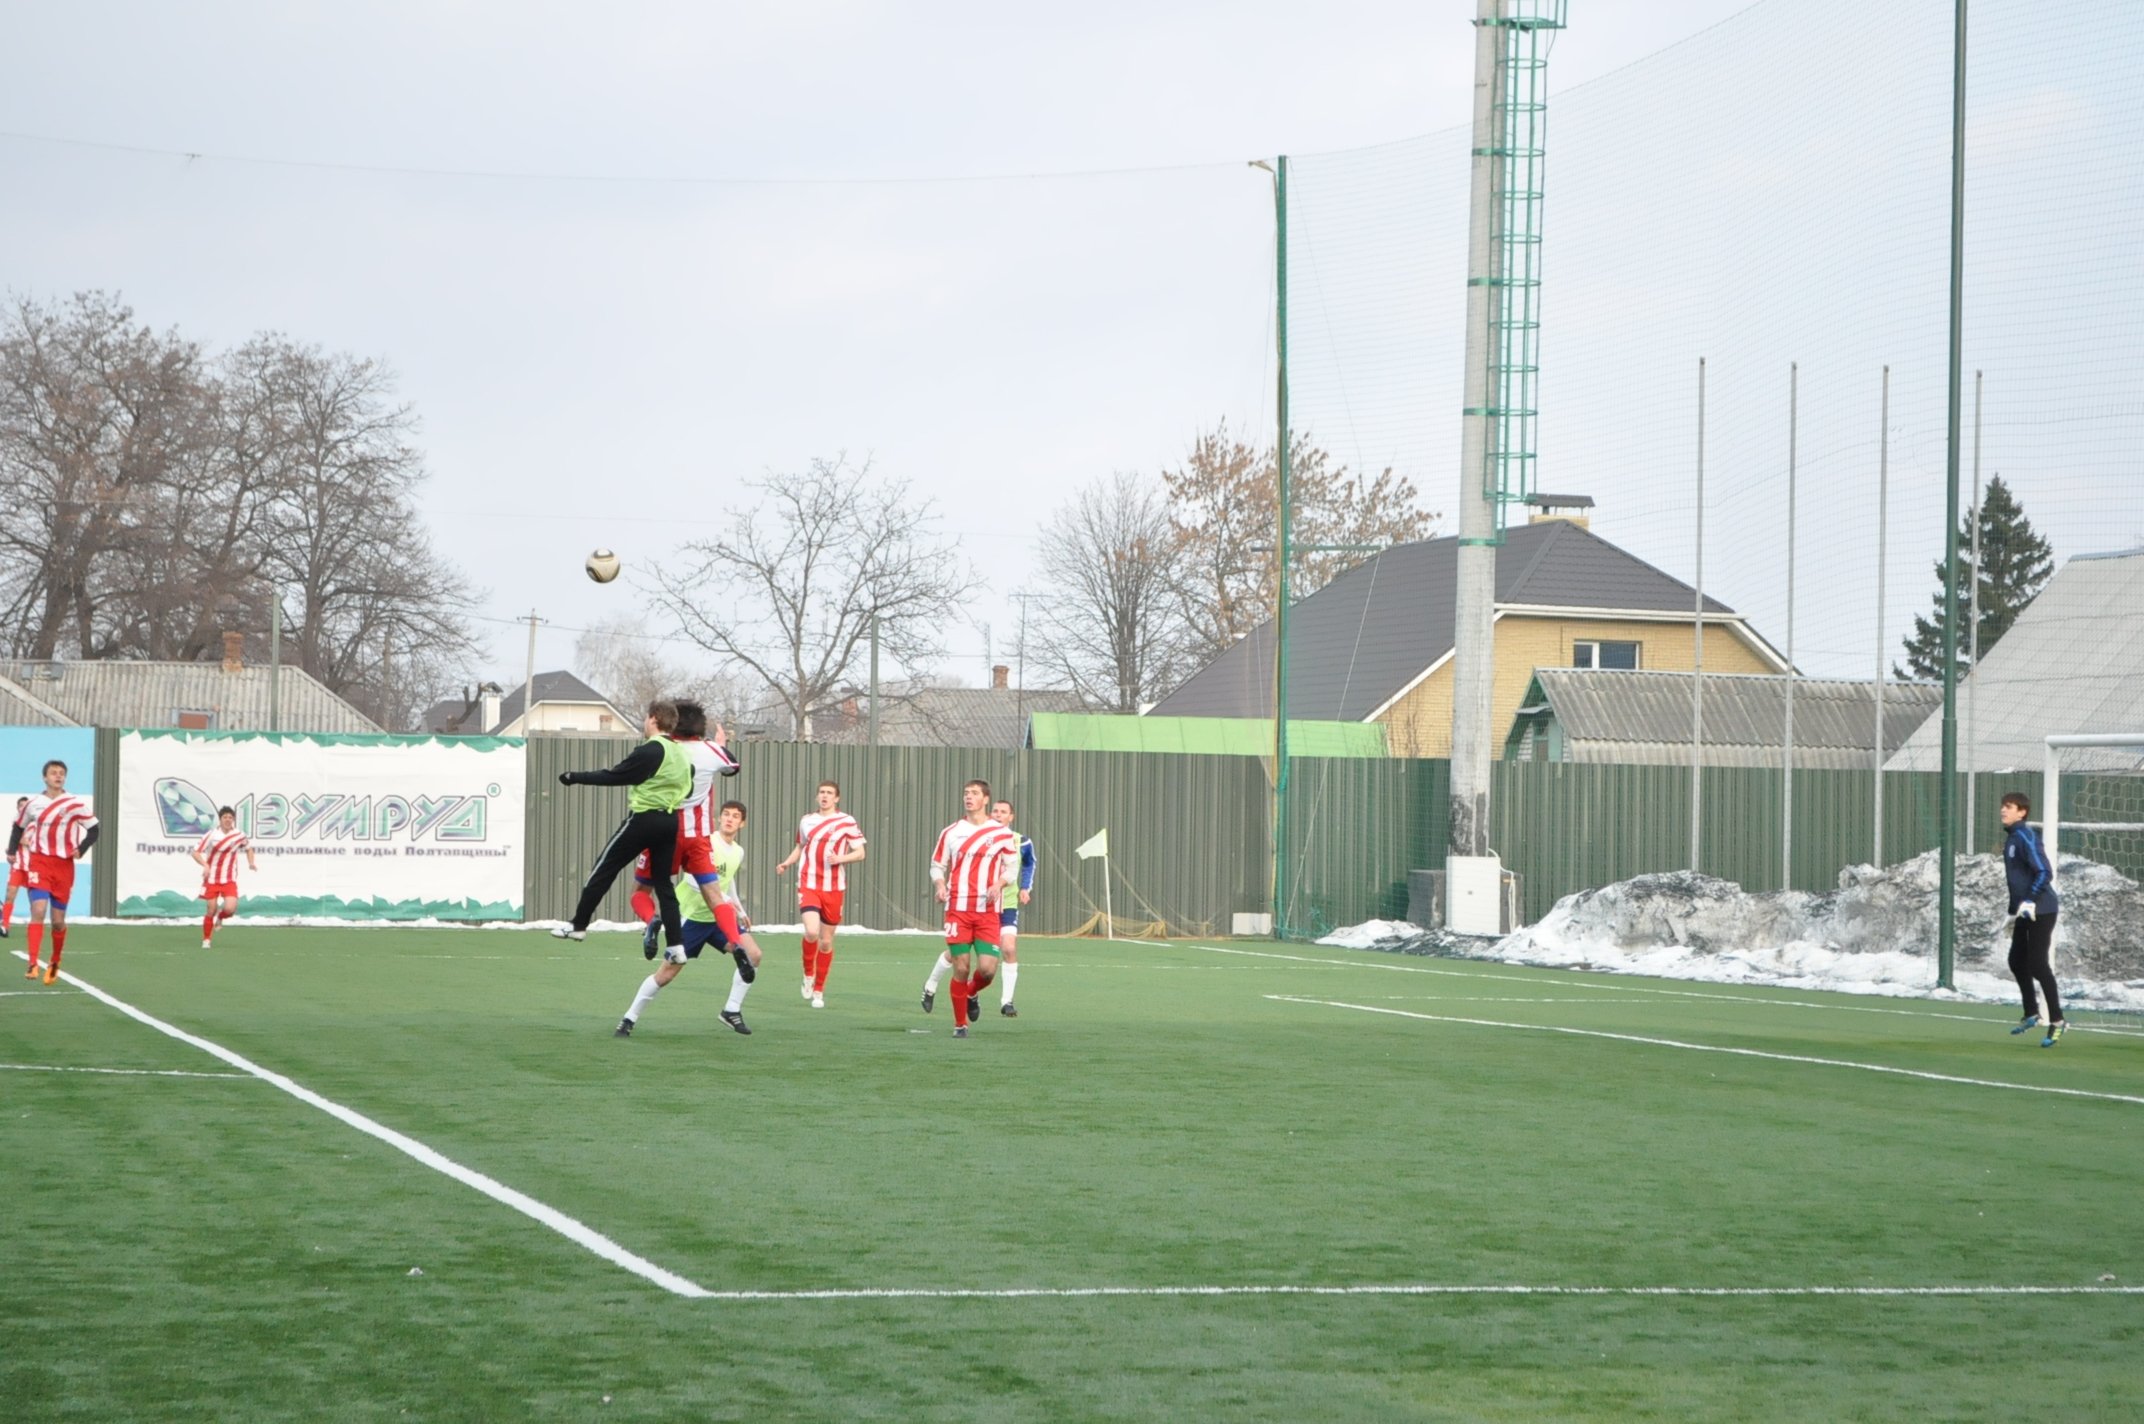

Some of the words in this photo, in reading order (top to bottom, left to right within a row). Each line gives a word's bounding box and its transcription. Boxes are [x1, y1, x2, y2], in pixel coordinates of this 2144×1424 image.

[136, 842, 195, 856] Природ
[238, 844, 346, 856] неральные
[405, 846, 507, 859] Полтавщины
[944, 922, 958, 937] 24
